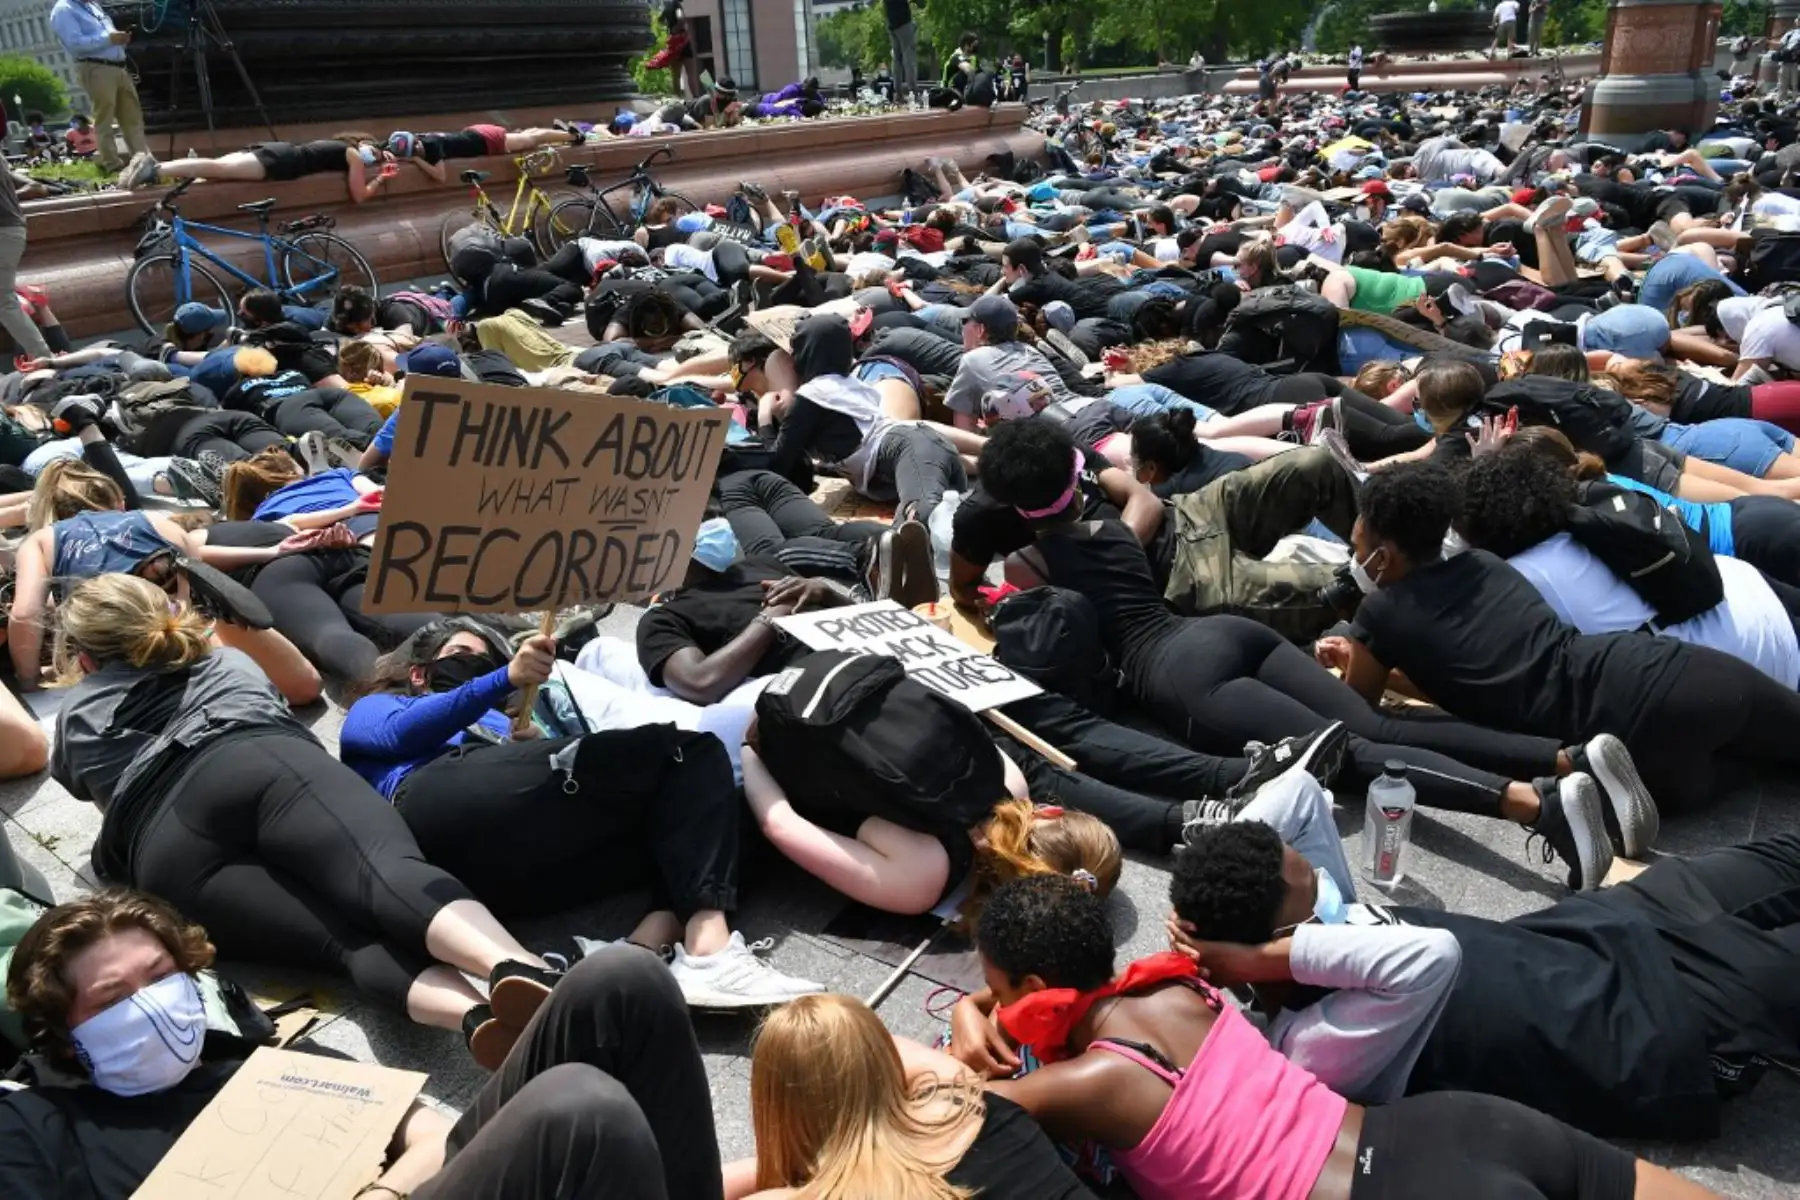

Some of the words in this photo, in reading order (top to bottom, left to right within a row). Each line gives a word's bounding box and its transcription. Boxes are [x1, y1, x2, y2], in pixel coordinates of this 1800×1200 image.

[411, 391, 572, 469] THINK
[582, 412, 722, 481] ABOUT
[477, 475, 581, 517] WHAT
[372, 521, 681, 607] RECORDED
[908, 654, 1016, 694] TURES
[280, 1074, 371, 1098] Walmart.com
